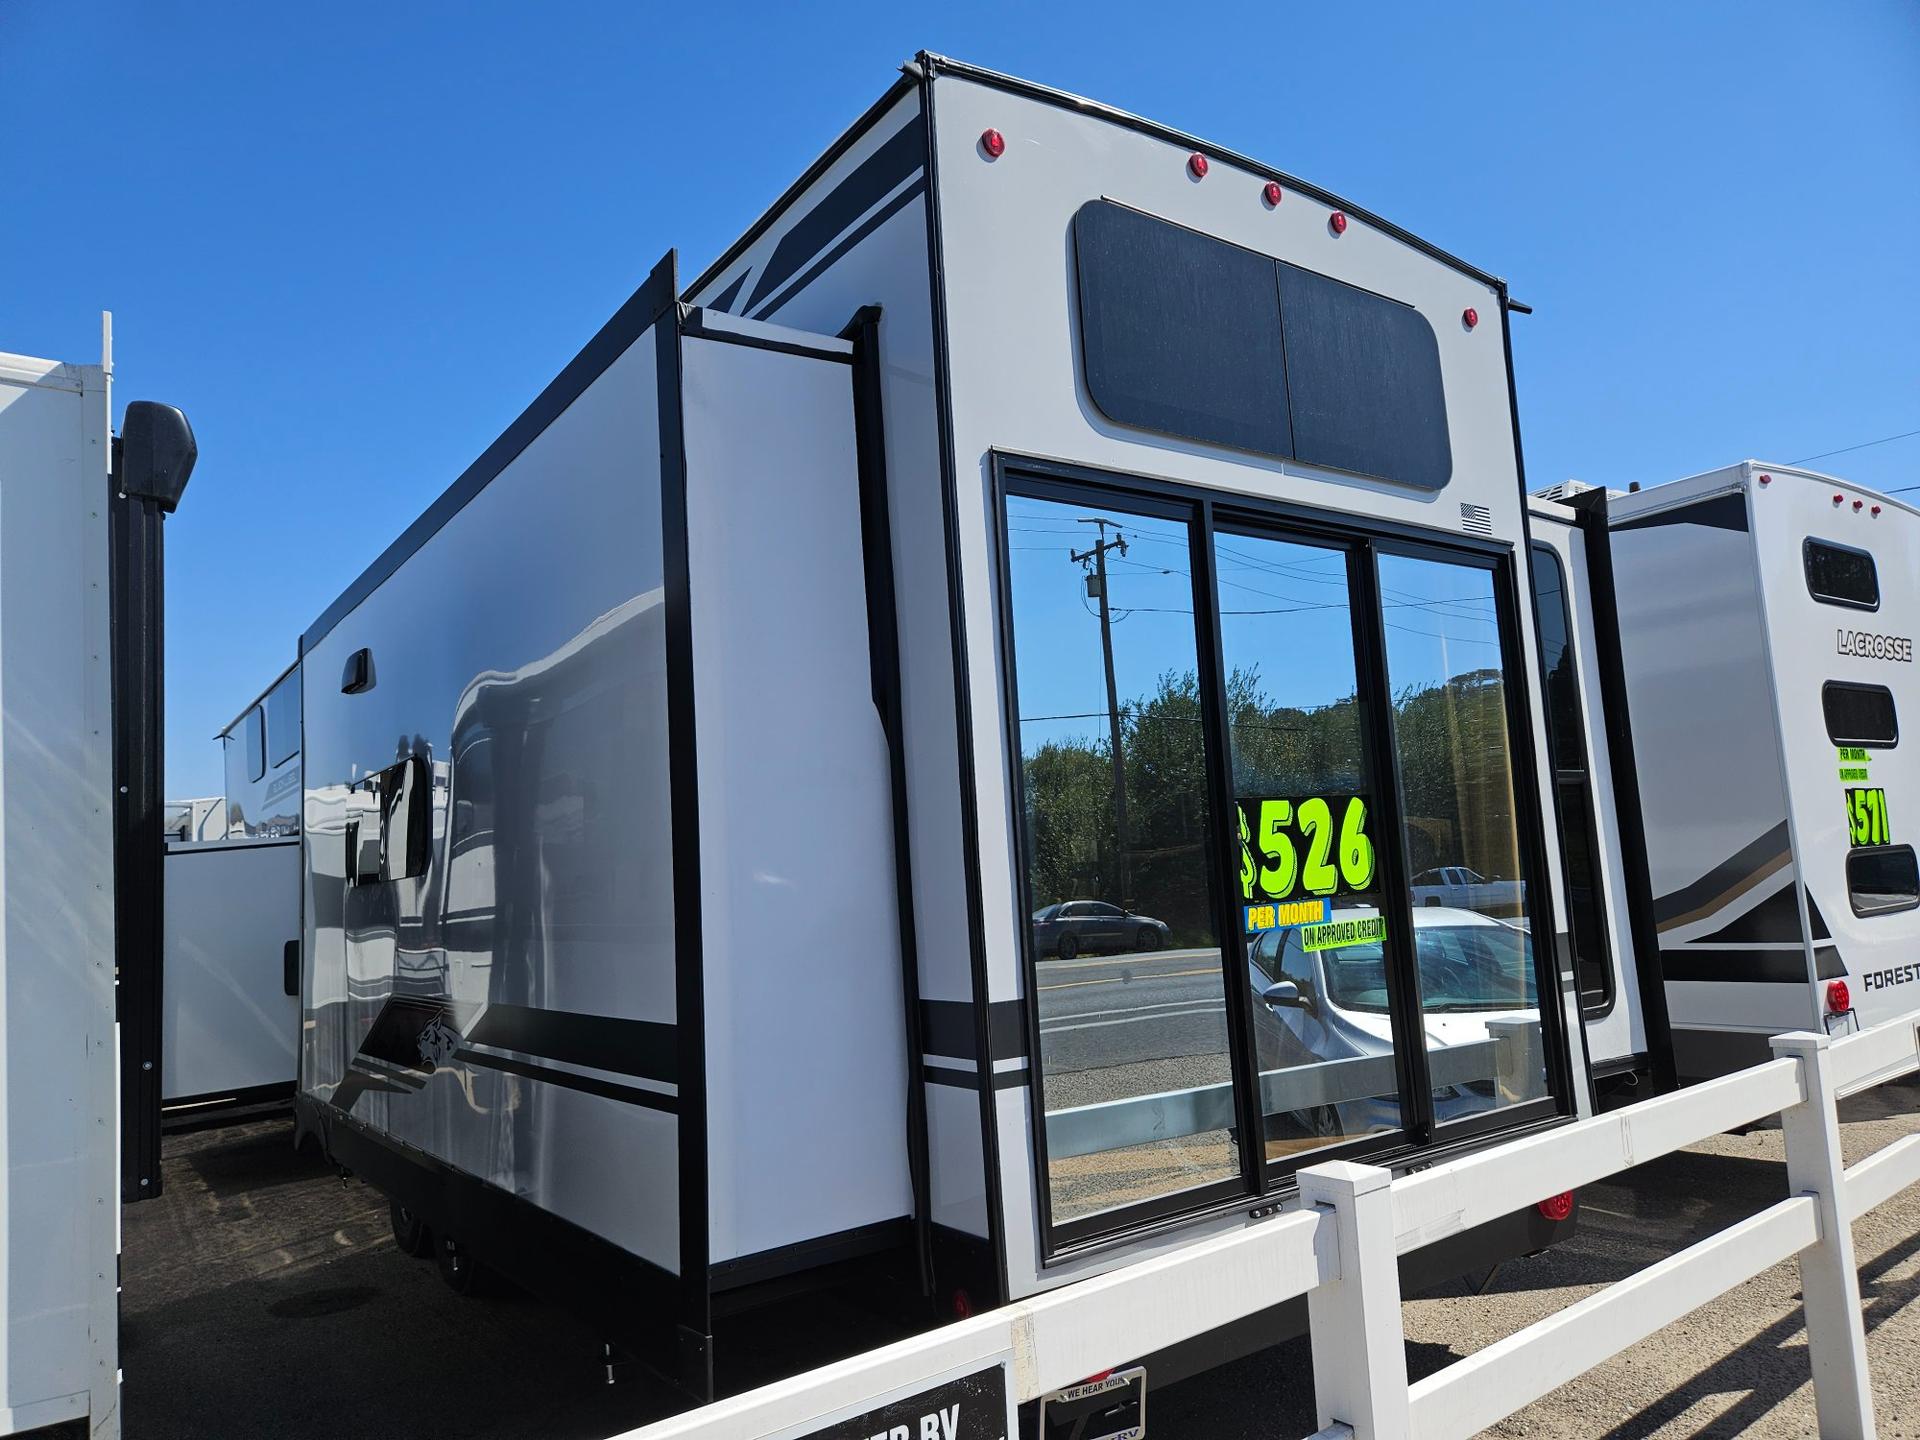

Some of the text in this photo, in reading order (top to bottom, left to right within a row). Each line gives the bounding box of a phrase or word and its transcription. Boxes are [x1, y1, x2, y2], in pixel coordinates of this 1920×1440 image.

[1837, 629, 1912, 662] LACROSSE
[1236, 796, 1376, 899] $526
[1248, 900, 1324, 930] PER MONTH
[1304, 918, 1385, 947] ON APPROVED CREDIT
[1862, 962, 1920, 992] FOREST
[1068, 1390, 1080, 1399] WE
[1082, 1383, 1103, 1395] HEAR
